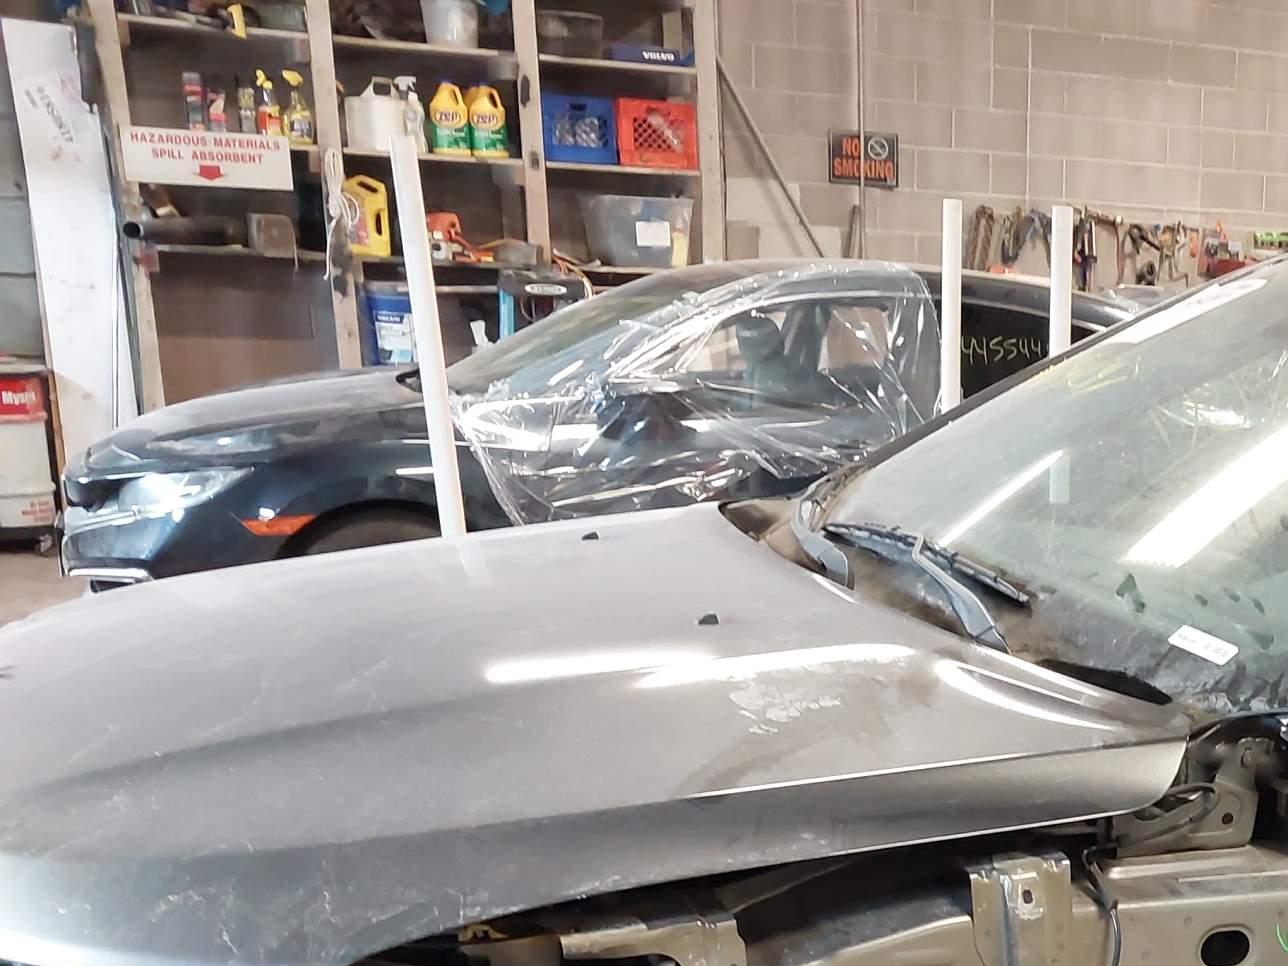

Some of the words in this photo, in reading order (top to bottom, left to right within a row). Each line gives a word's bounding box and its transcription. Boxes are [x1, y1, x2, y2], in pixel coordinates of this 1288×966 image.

[642, 51, 675, 61] VOLVO
[130, 131, 208, 147] HAZARDOUS
[212, 137, 281, 151] MATERIALS
[842, 137, 861, 157] NO
[151, 147, 184, 161] SPILL
[191, 151, 264, 164] ABSORBENT
[833, 157, 894, 180] SMOKING
[961, 336, 1049, 365] 445544
